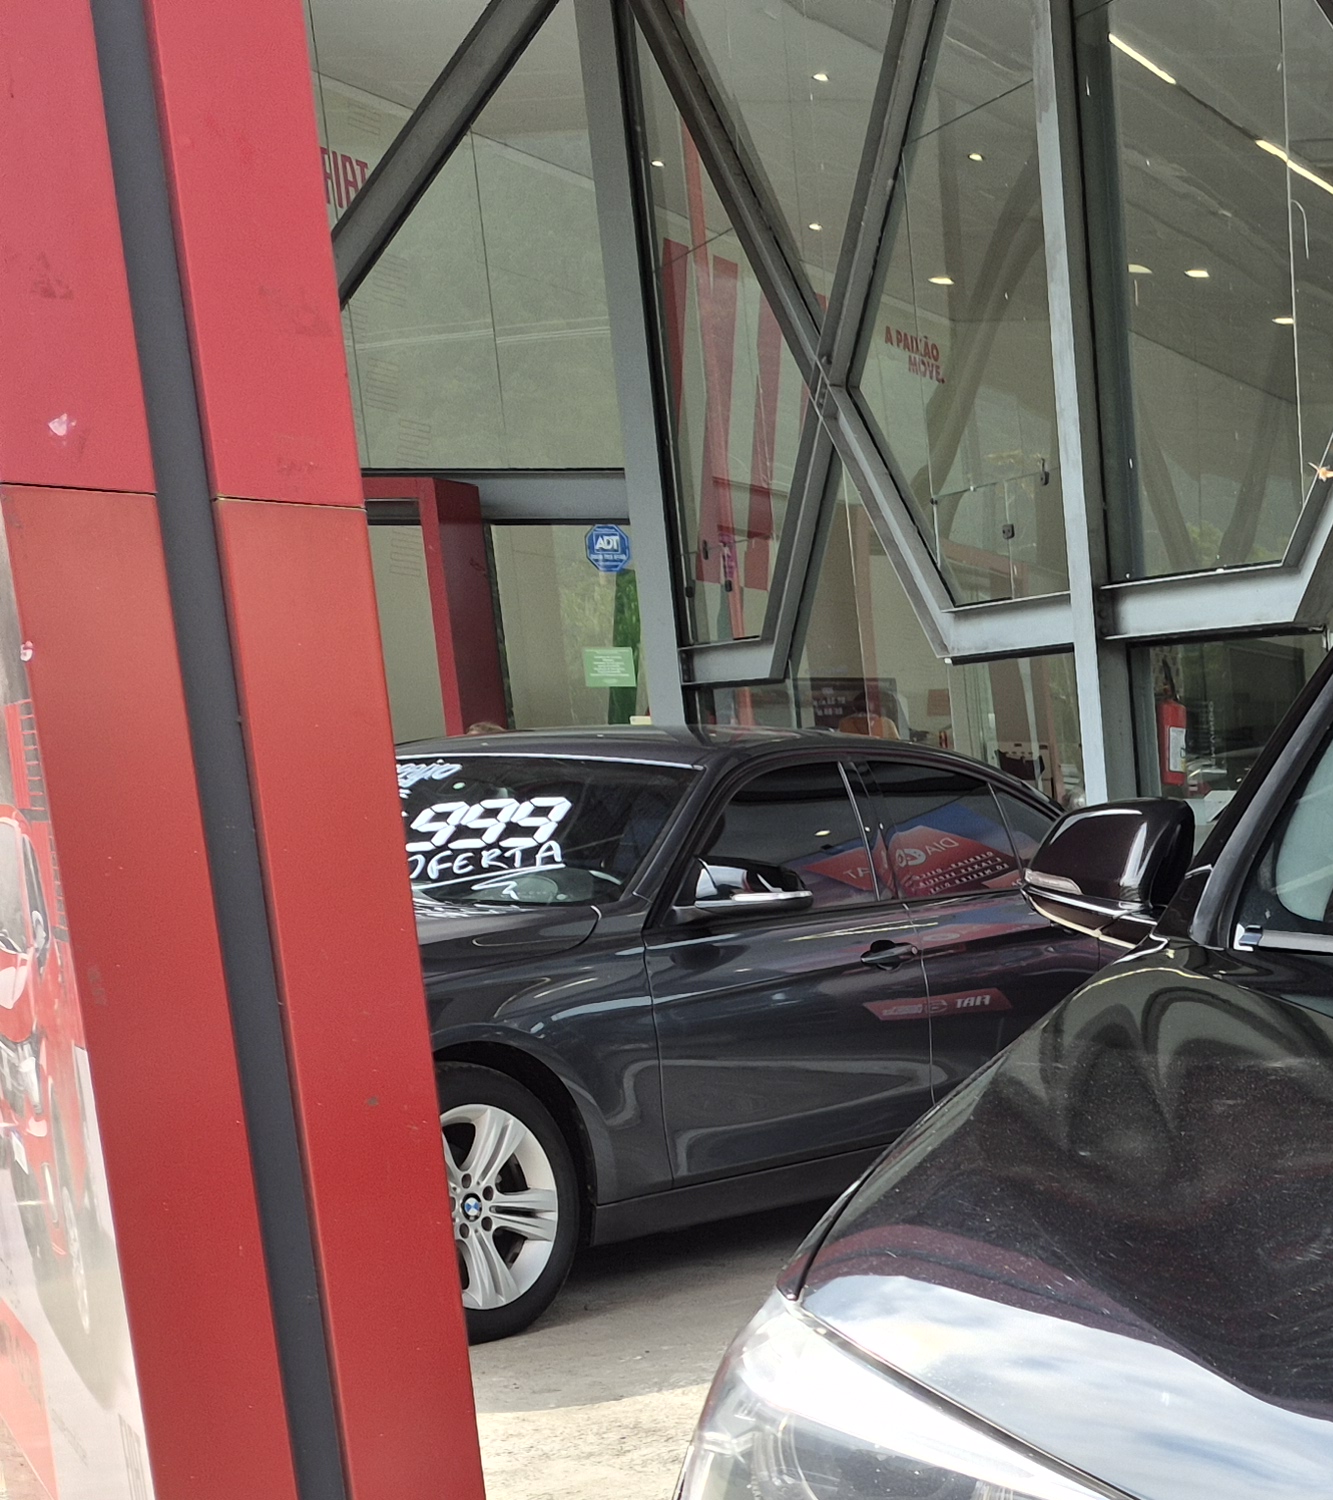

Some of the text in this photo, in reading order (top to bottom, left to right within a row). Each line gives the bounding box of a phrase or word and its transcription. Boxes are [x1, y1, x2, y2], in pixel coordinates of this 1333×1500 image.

[885, 326, 893, 346] A
[595, 535, 619, 550] ADT
[401, 796, 572, 853] 999
